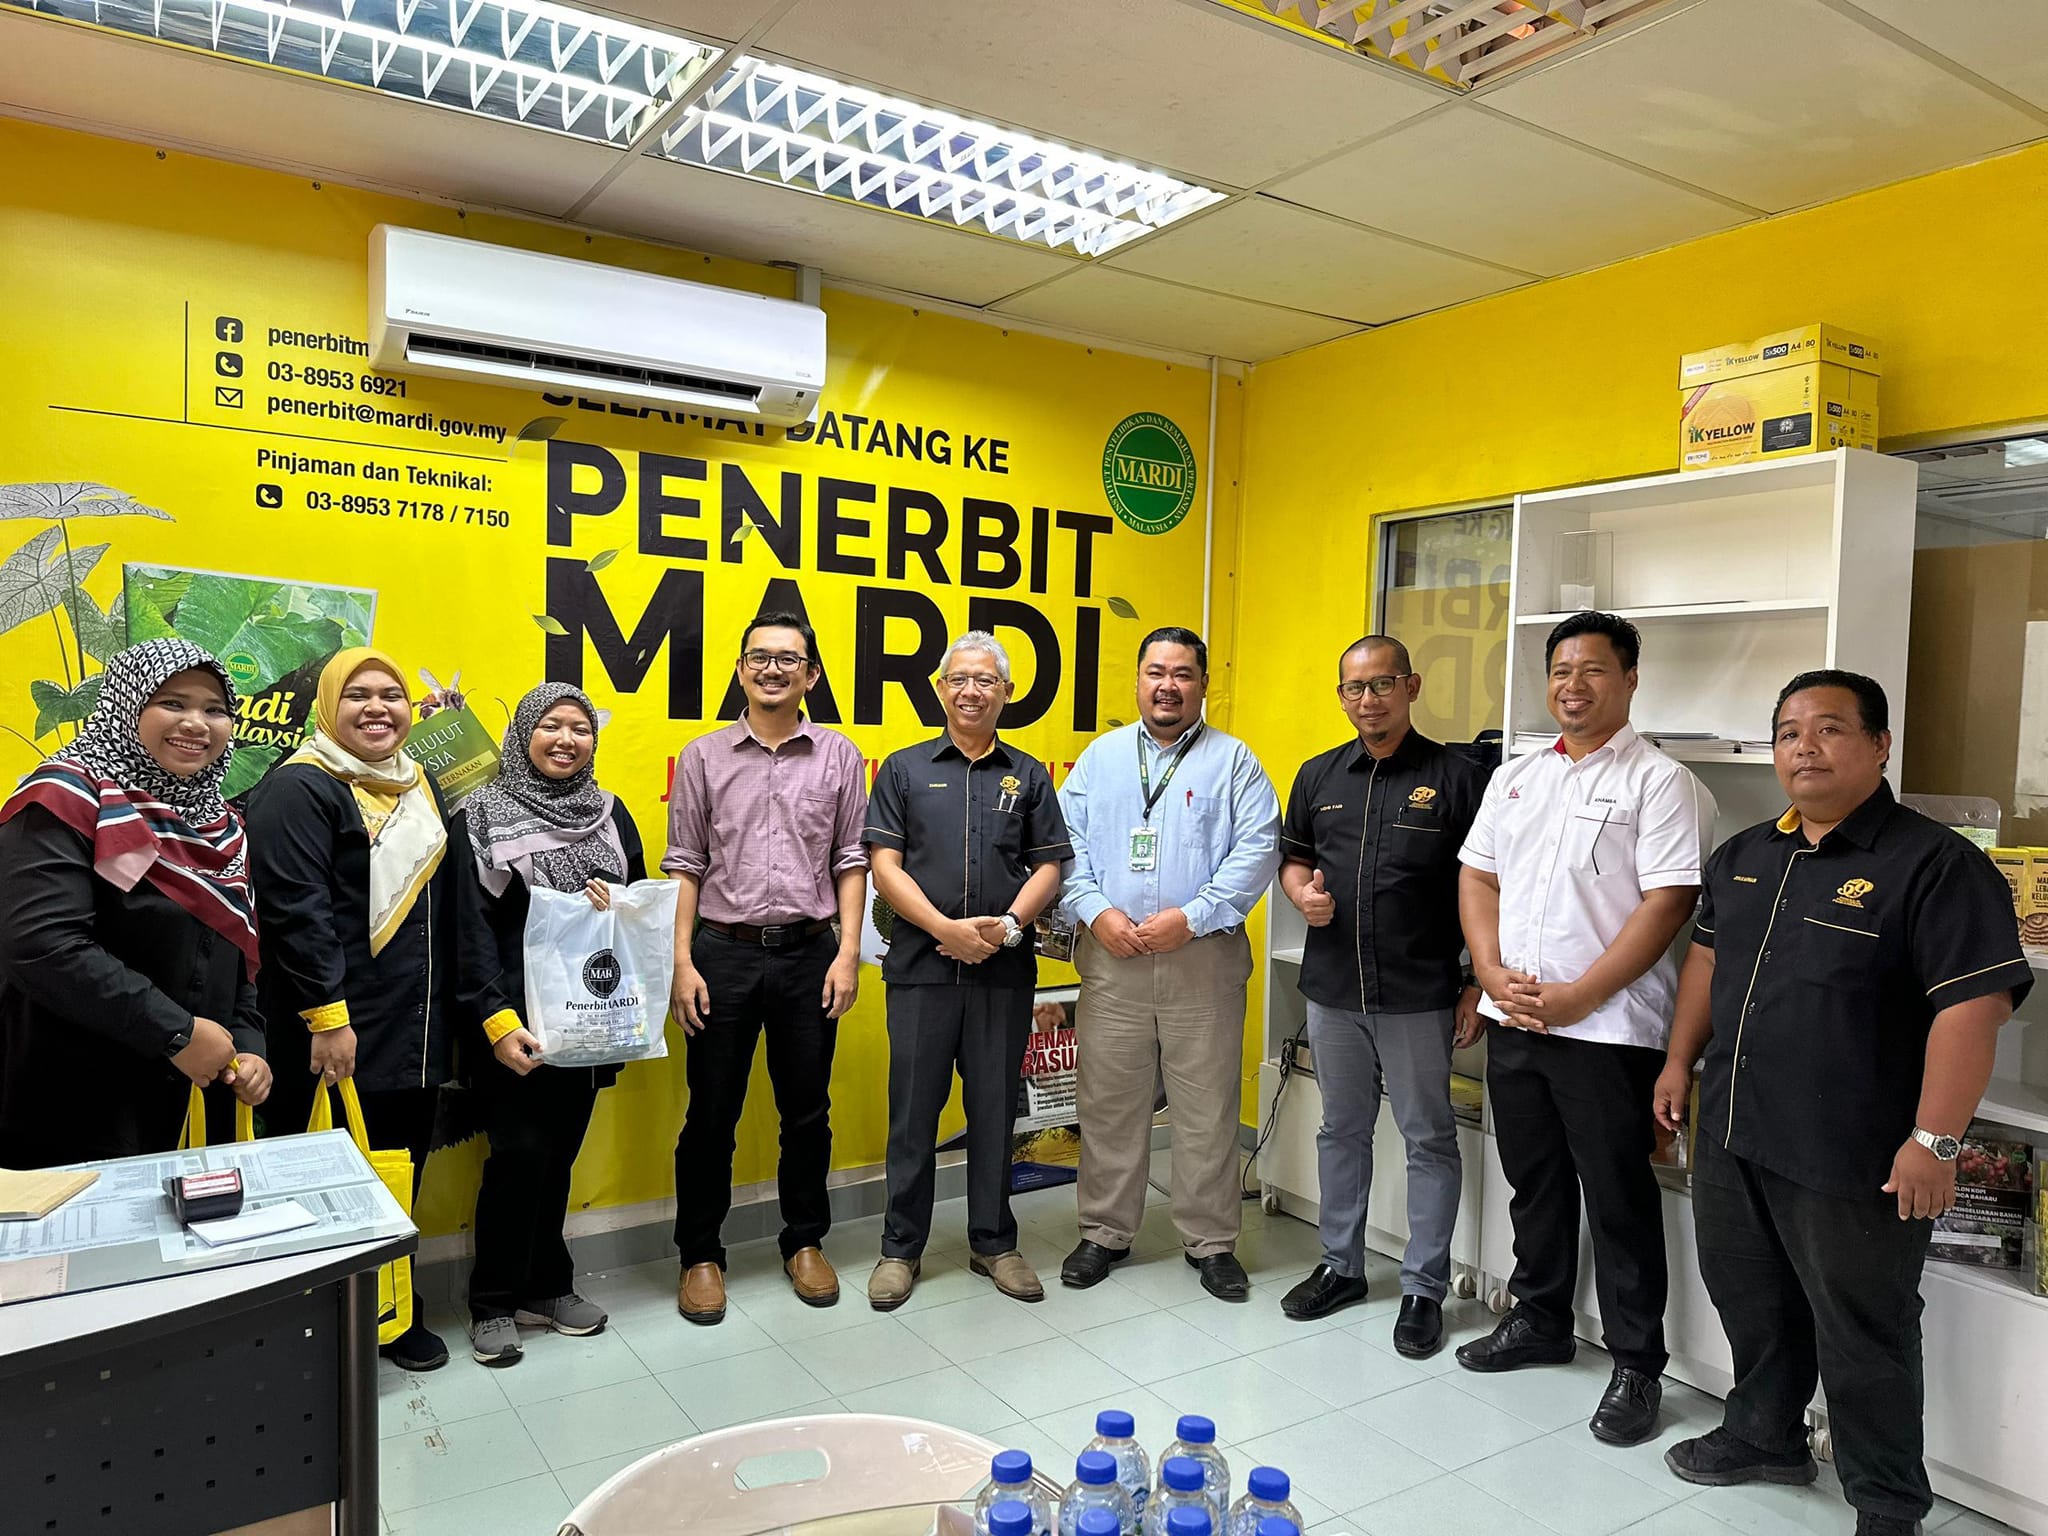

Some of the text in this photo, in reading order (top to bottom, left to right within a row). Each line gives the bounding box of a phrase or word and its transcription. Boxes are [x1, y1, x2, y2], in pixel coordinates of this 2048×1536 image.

[268, 362, 407, 398] 03-8953 6921
[268, 396, 507, 443] penerbit@mardi.gov.my
[1705, 422, 1755, 440] YELLOW
[257, 448, 492, 492] Pinjaman dan Teknikal:
[963, 434, 1009, 474] KE
[1116, 458, 1183, 490] MARDI
[306, 491, 509, 528] 03-8953 7178 / 7150
[546, 439, 1113, 598] PENERBIT
[1127, 517, 1169, 532] MALAYSIA
[545, 556, 1100, 733] MARDI
[230, 662, 256, 673] MARDI
[565, 1001, 607, 1011] Penerbit
[1021, 1046, 1078, 1078] RASU
[1970, 1194, 1998, 1202] BAHARU
[1971, 1187, 1986, 1195] KOPI
